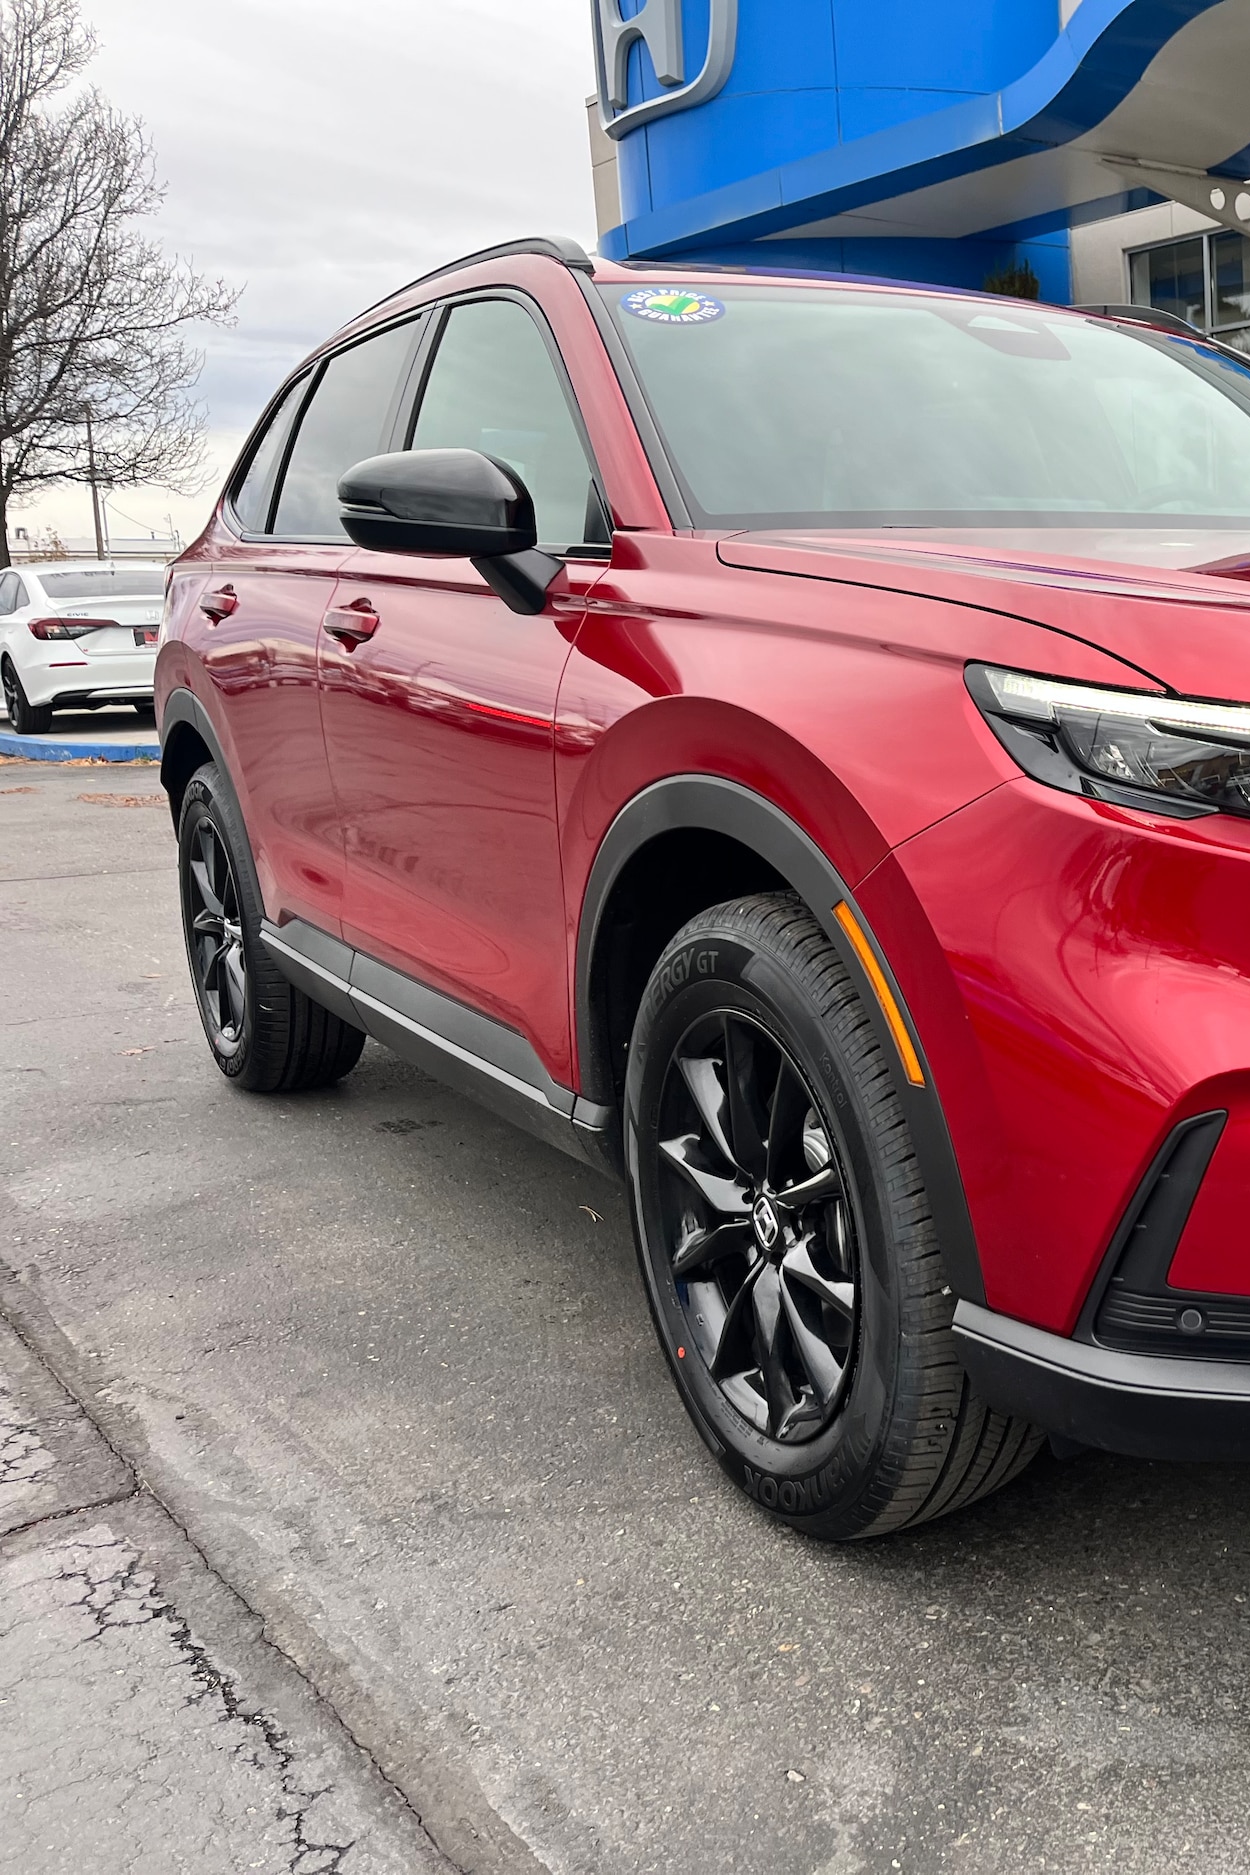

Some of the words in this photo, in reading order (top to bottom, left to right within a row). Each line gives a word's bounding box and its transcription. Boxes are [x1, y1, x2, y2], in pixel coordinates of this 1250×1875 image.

[627, 290, 657, 303] BEST
[659, 289, 707, 301] PRICE
[638, 306, 720, 322] GUARANTEE
[696, 951, 719, 974] GT
